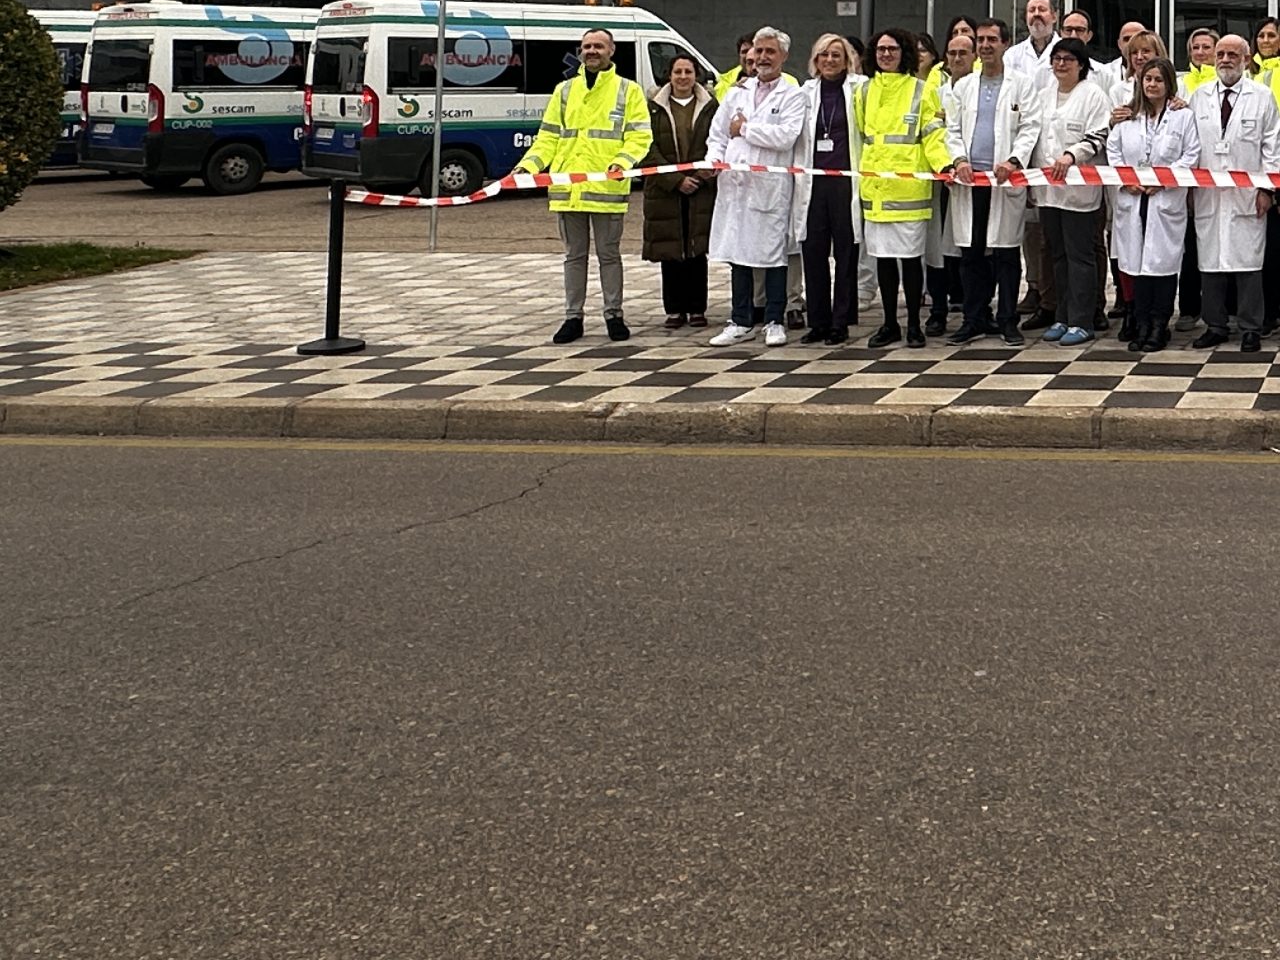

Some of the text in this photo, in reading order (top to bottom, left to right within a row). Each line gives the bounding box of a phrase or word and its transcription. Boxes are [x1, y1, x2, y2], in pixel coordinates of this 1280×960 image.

[205, 54, 302, 66] AMBULANCIA
[212, 104, 255, 114] sescam
[428, 108, 473, 119] sscam
[171, 120, 213, 130] CUP-002
